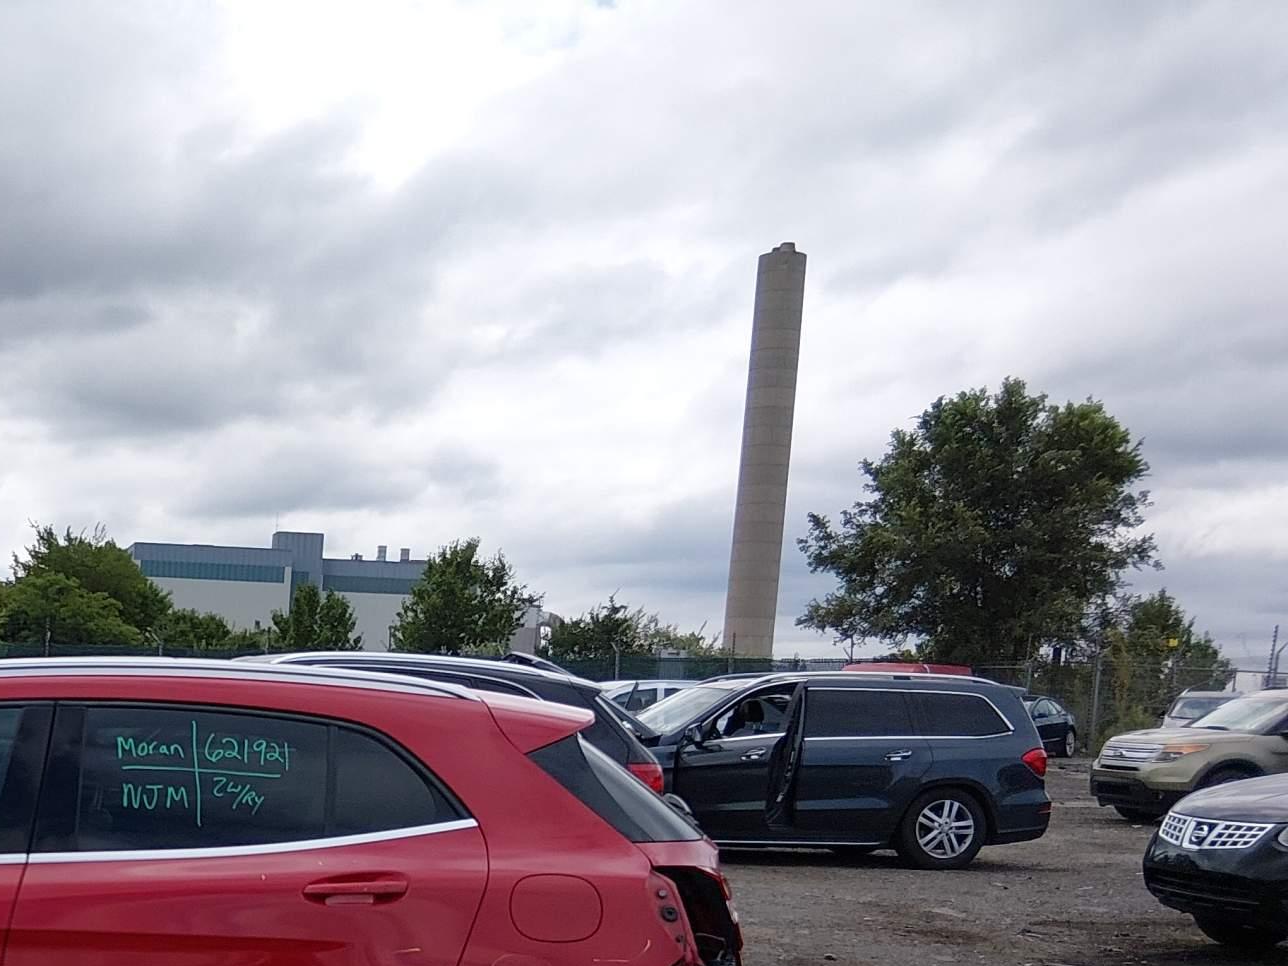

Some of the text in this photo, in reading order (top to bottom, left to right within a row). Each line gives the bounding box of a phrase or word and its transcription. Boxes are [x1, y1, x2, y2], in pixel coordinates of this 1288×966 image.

[116, 735, 185, 760] Moran
[204, 733, 289, 771] 621921
[122, 783, 189, 811] NJM
